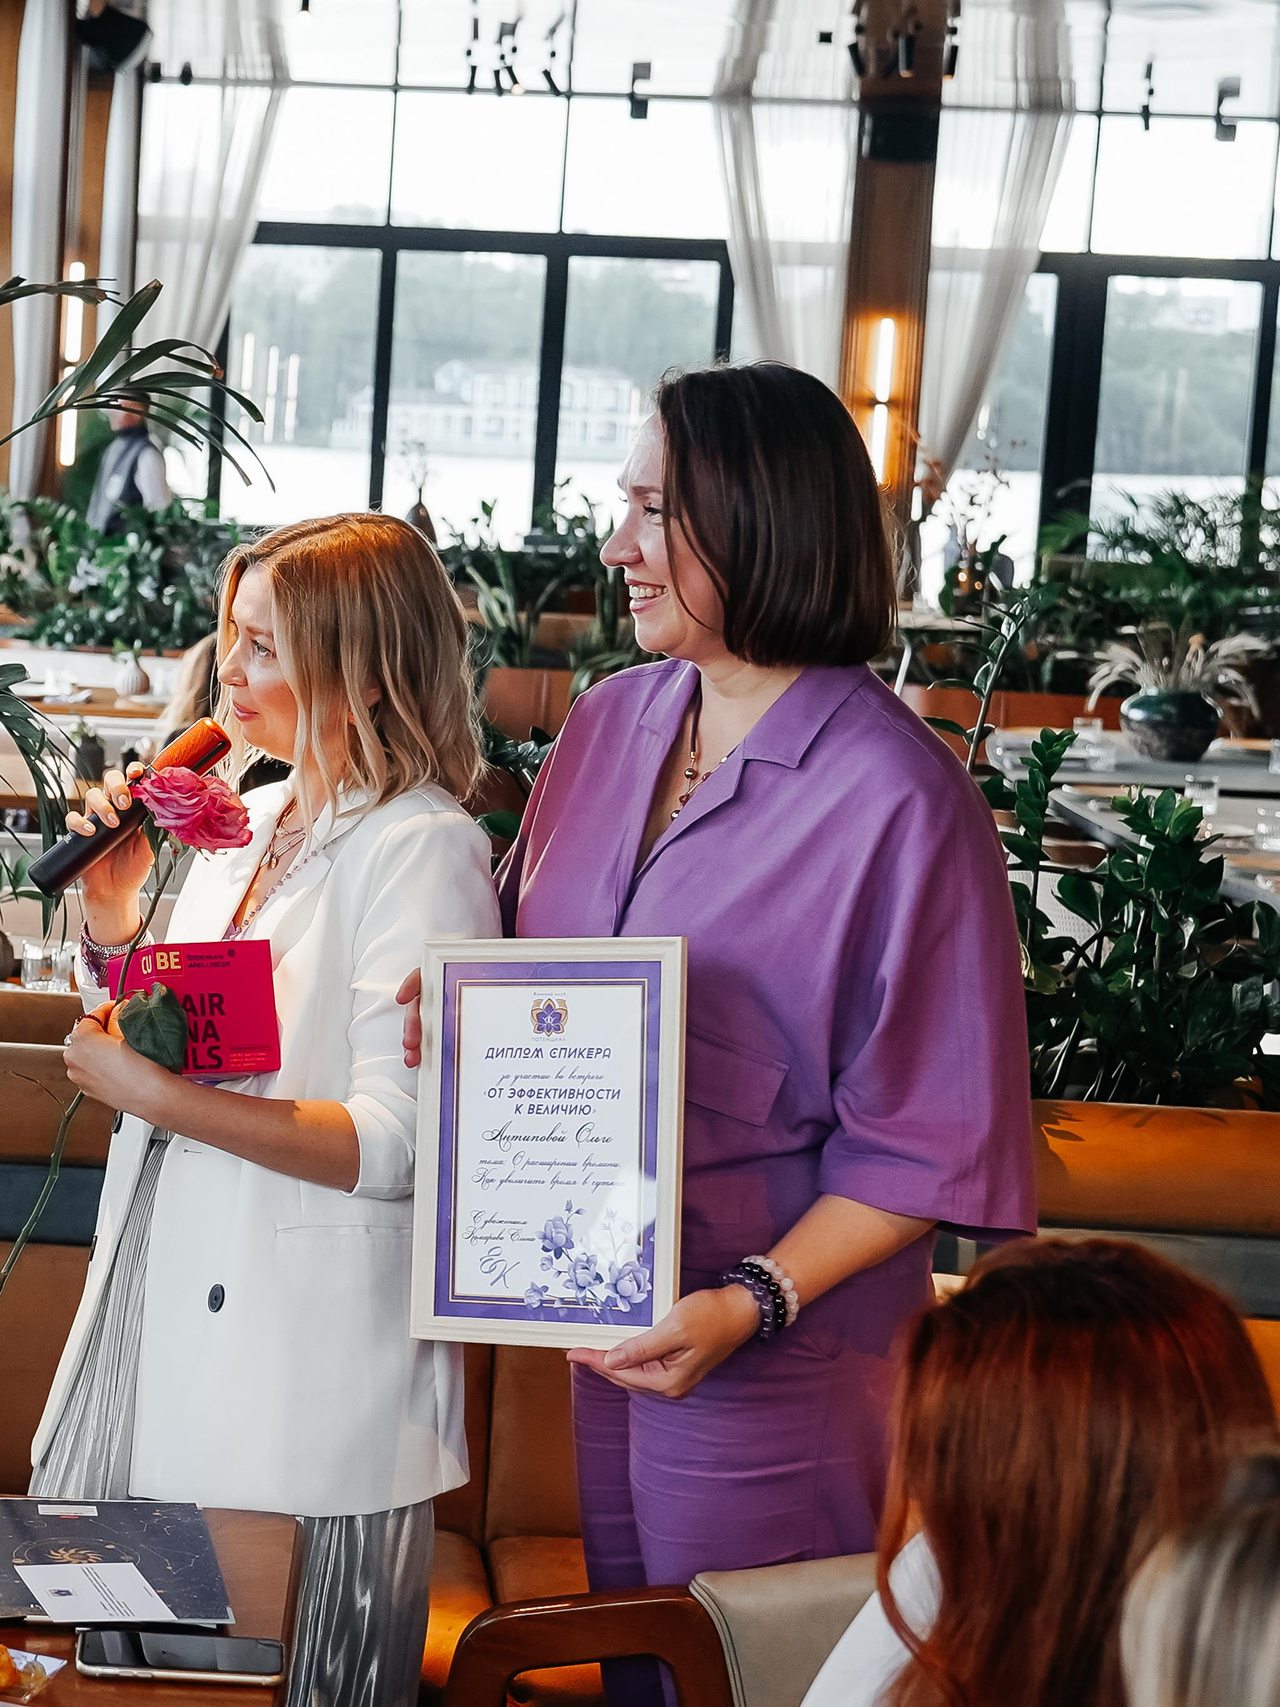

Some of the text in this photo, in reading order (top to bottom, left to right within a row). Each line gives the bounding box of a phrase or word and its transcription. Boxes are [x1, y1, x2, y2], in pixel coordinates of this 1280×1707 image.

[182, 992, 226, 1017] AIR
[484, 1047, 612, 1060] ДИПЛОМ СПИКЕРА
[507, 1088, 621, 1100] ЭФФЕКТИВНОСТИ
[514, 1103, 523, 1115] К
[482, 1120, 613, 1152] Антиповой Ольге
[471, 1166, 497, 1190] Как
